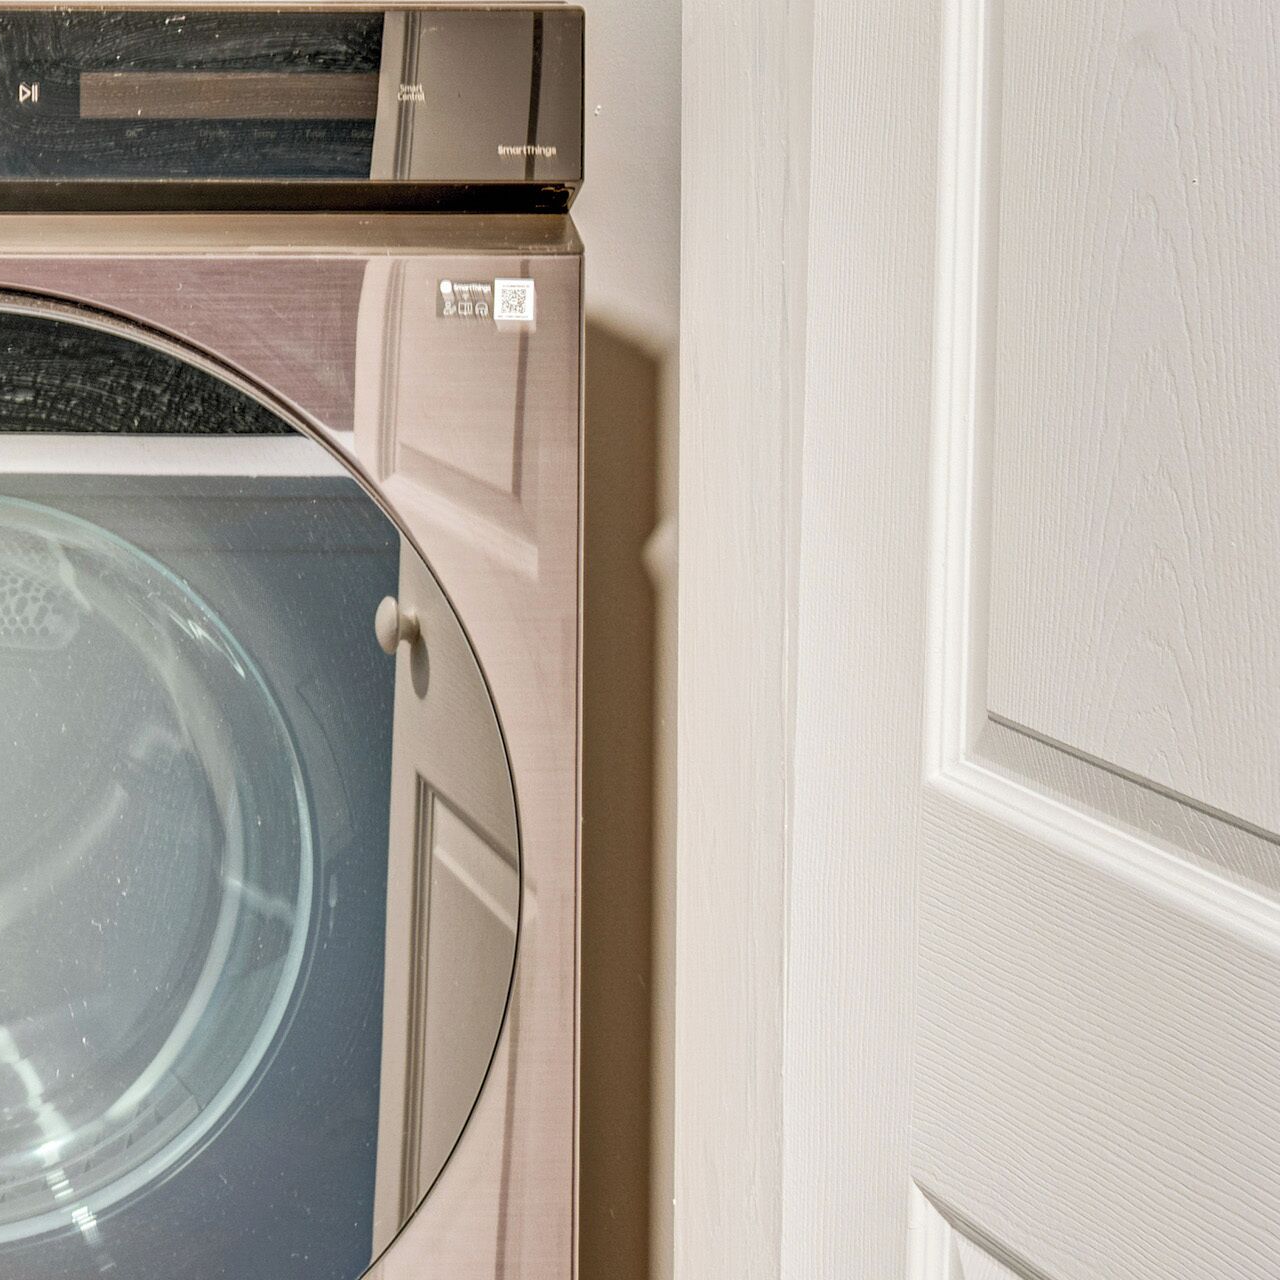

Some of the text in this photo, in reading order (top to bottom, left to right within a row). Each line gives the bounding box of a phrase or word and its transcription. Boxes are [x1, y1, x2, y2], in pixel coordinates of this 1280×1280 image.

[400, 83, 423, 92] Smart
[397, 92, 425, 101] Control
[498, 144, 557, 157] SmartThings
